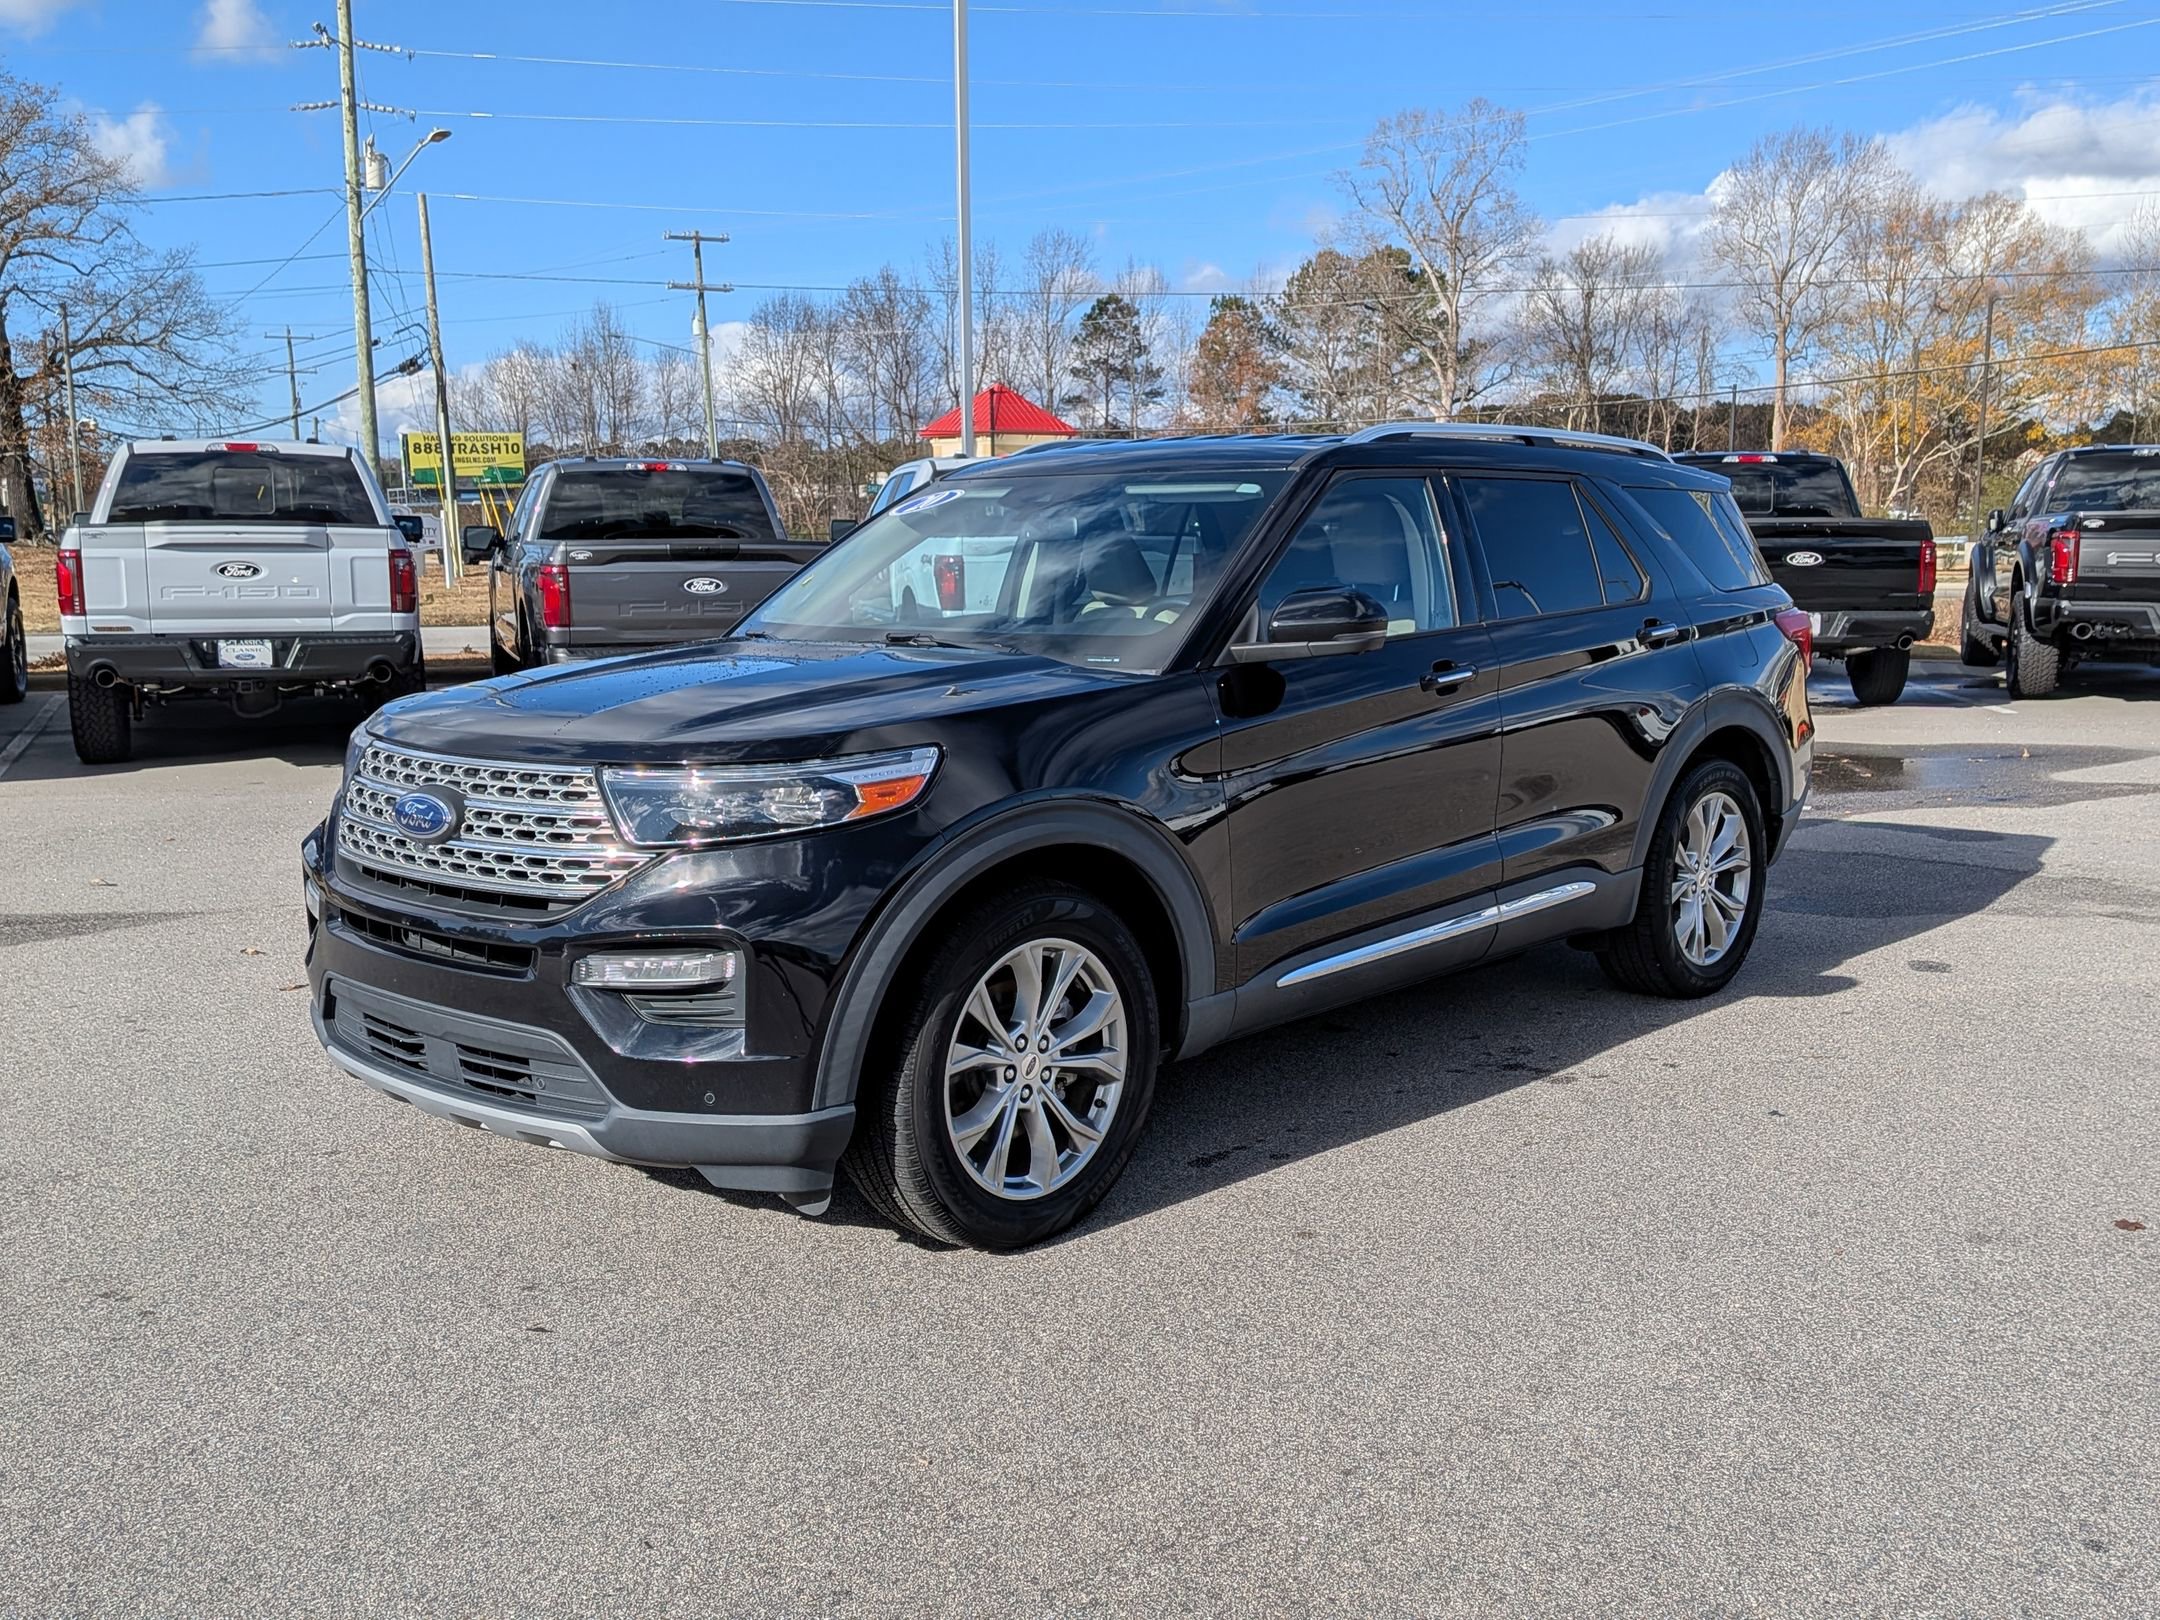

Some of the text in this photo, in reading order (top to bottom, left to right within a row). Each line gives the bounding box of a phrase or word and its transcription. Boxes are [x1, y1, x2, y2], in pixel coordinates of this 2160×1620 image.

[224, 564, 254, 577] Ford
[161, 585, 320, 601] F-150
[690, 579, 717, 591] Ford
[617, 600, 754, 617] F-15
[400, 800, 435, 829] Ford
